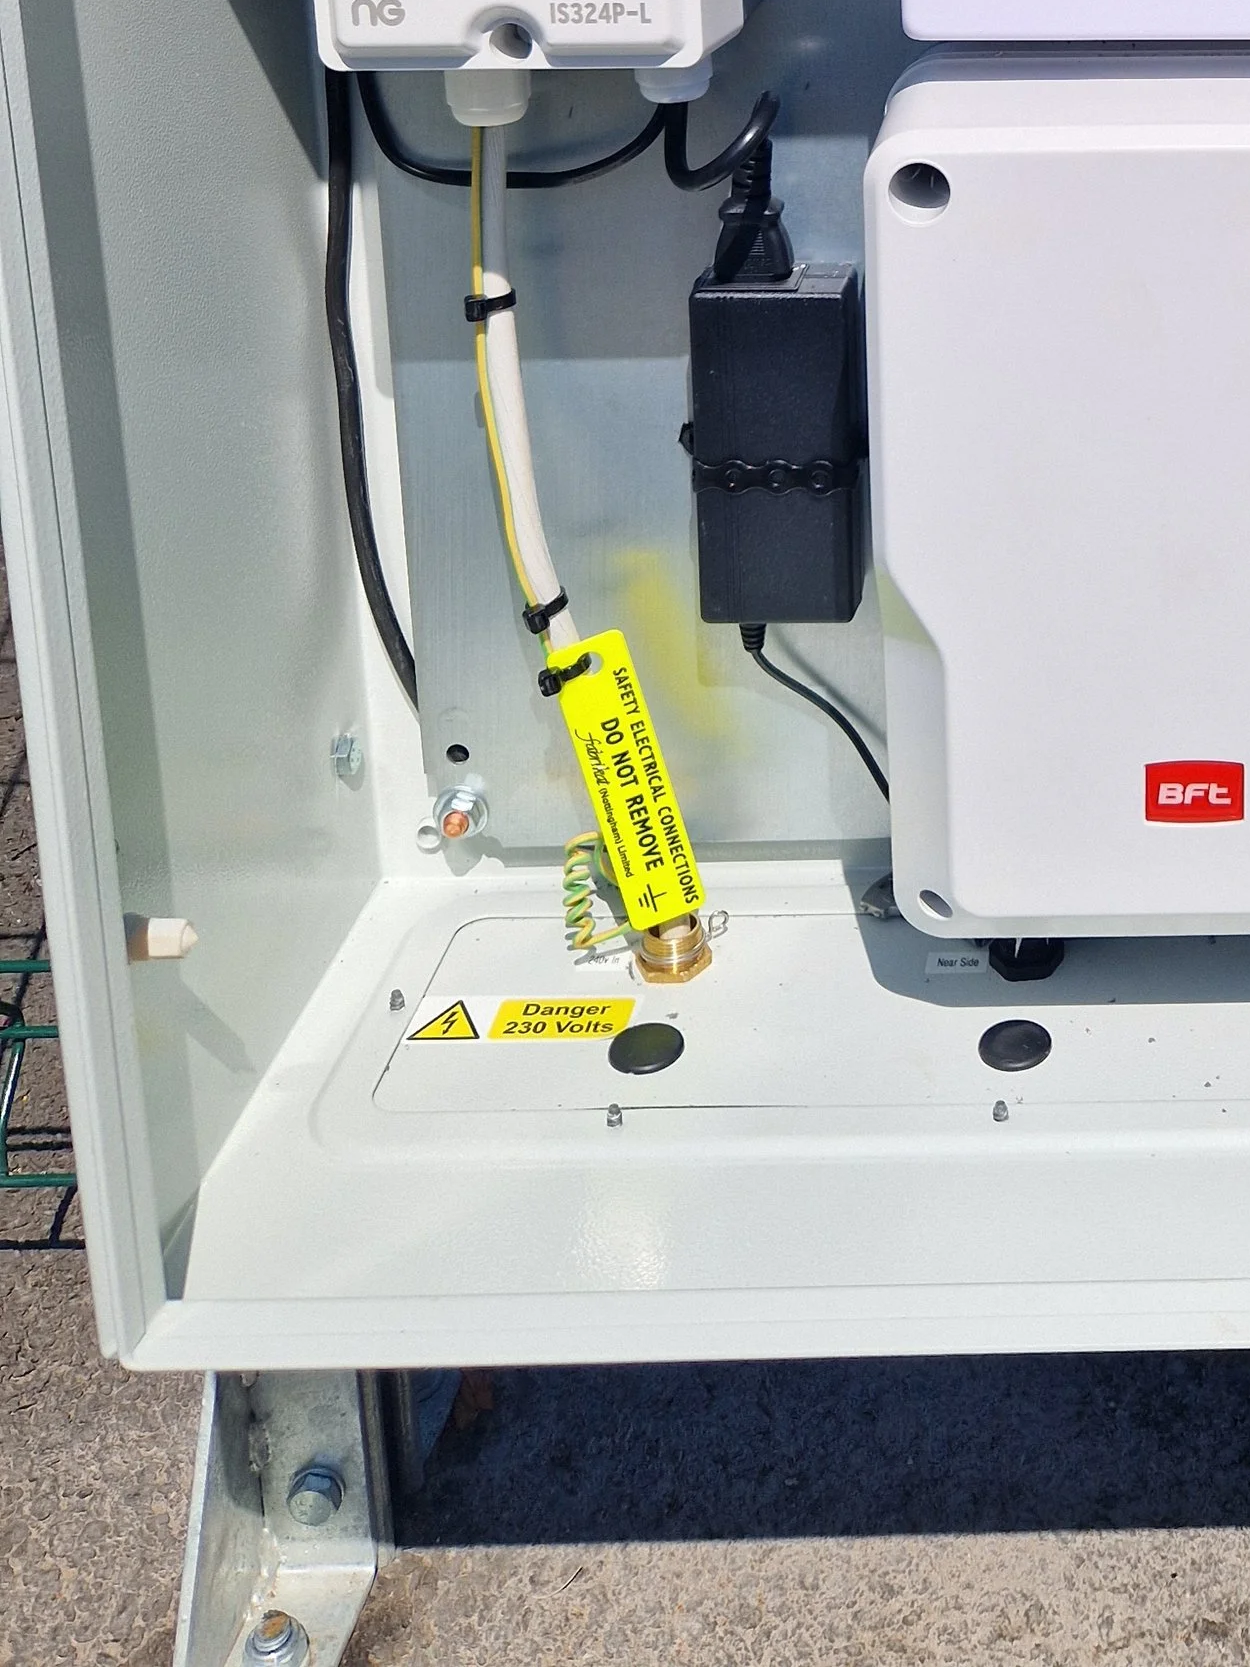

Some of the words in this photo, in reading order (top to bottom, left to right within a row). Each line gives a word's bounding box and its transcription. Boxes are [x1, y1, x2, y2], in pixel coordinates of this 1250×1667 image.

[549, 2, 652, 24] IS324P-L
[600, 717, 622, 745] DO
[612, 750, 640, 788] NOT
[626, 793, 665, 871] REMOVE
[613, 666, 640, 715] SAFETY
[630, 720, 666, 803] ELECTRICAL
[658, 806, 699, 905] CONNECTIONS
[599, 787, 622, 843] (Nottingham)
[616, 844, 634, 877] Limited
[936, 957, 957, 967] Near
[959, 956, 979, 967] Side
[521, 1003, 612, 1017] Danger
[502, 1021, 548, 1035] 230
[556, 1020, 615, 1034] Volts
